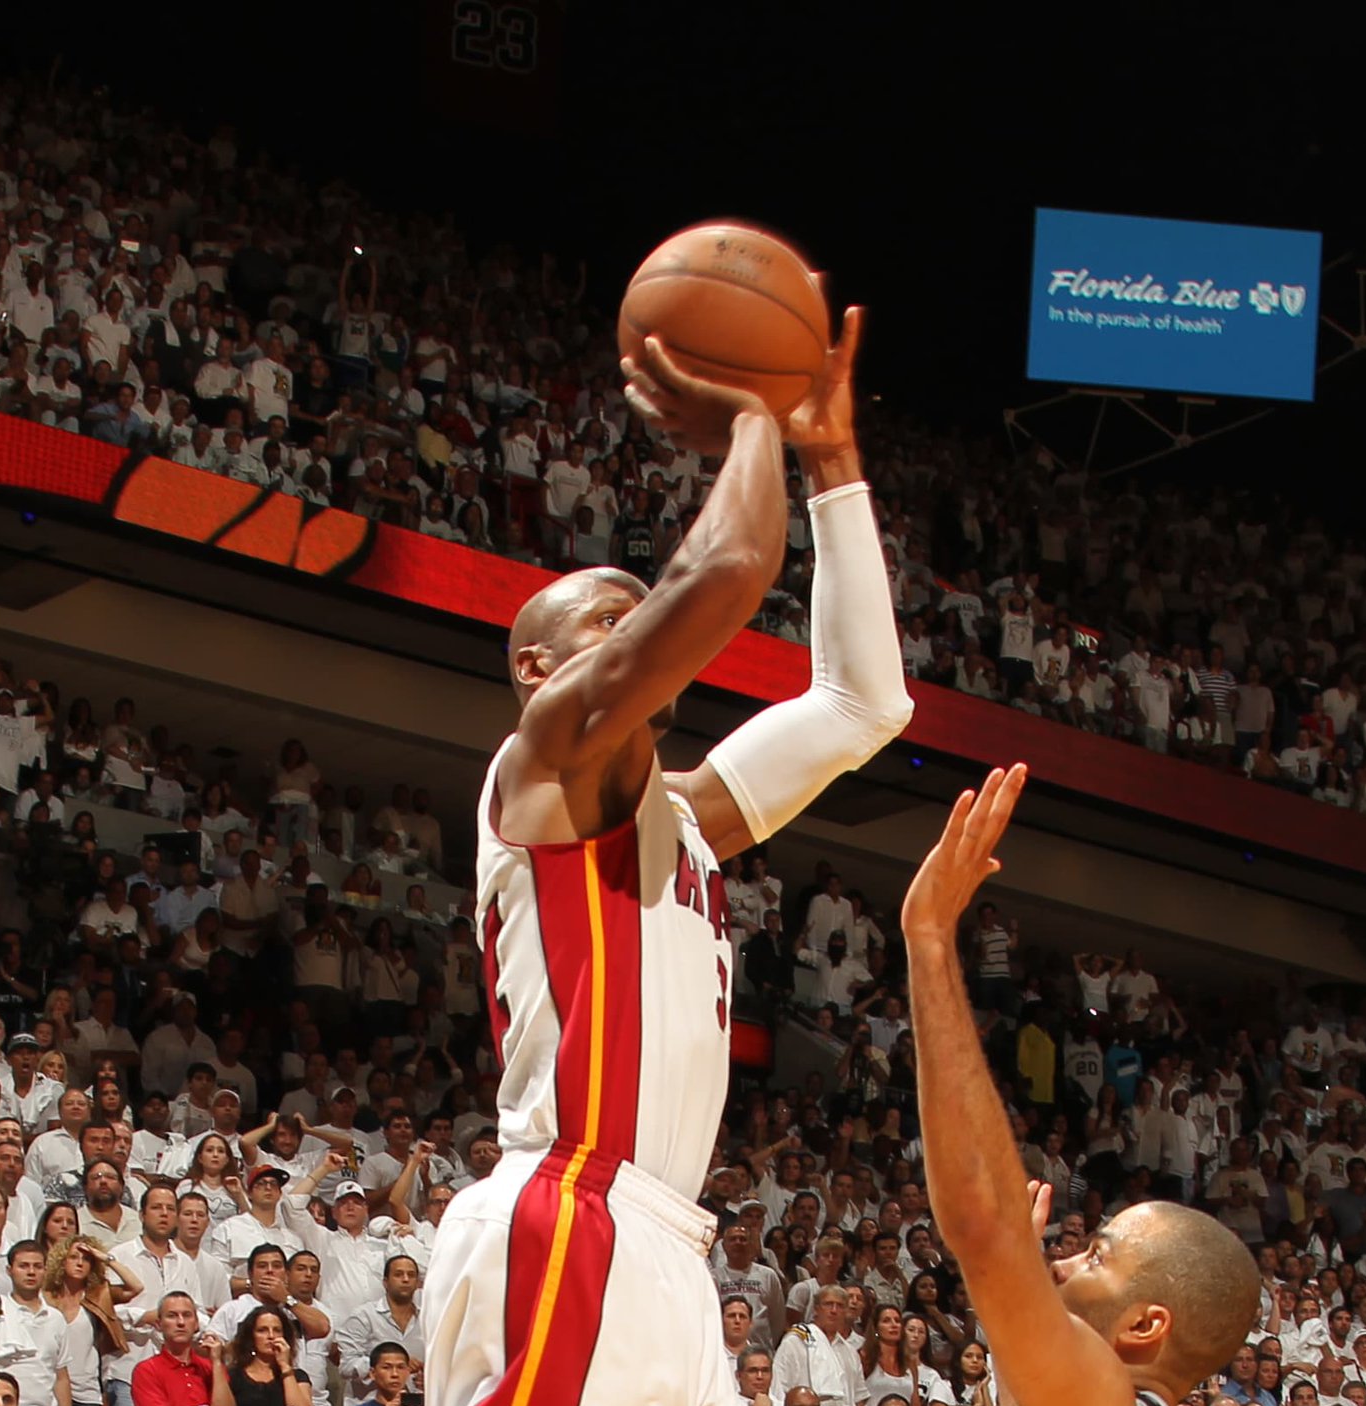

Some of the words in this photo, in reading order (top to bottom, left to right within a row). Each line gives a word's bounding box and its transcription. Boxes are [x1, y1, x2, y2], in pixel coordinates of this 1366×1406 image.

[1047, 268, 1168, 304] Florida
[1172, 279, 1241, 310] Blue
[1048, 305, 1064, 321] In
[1067, 306, 1094, 325] the
[1096, 310, 1151, 330] pursuit
[1153, 313, 1172, 331] of
[1173, 316, 1223, 335] health
